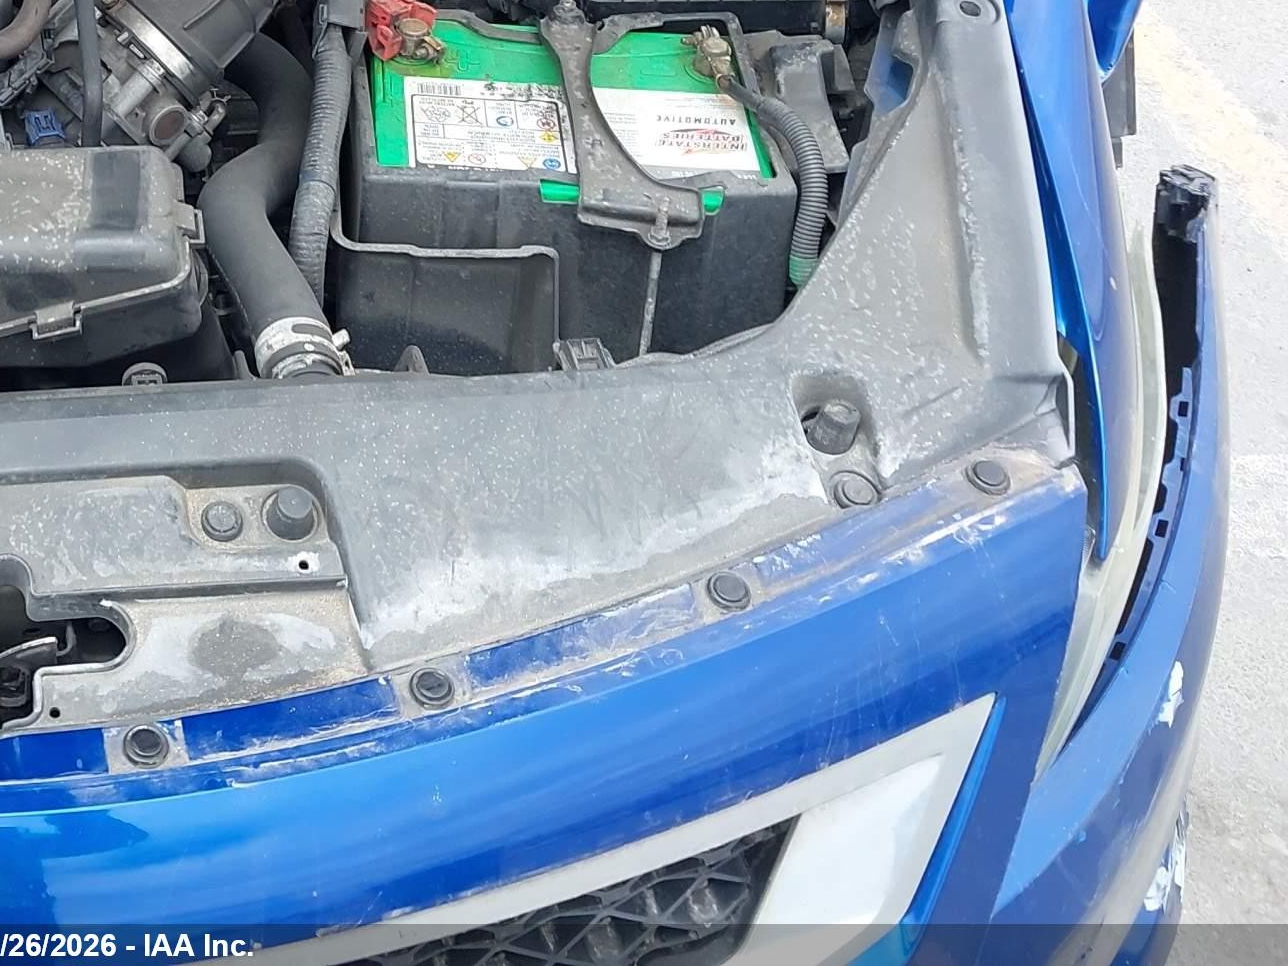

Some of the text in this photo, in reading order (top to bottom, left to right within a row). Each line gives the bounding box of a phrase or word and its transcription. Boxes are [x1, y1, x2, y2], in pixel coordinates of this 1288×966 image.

[656, 115, 736, 126] AUTOMOTIVE
[663, 132, 743, 143] BATTERIES
[658, 139, 747, 151] INTERSTATE
